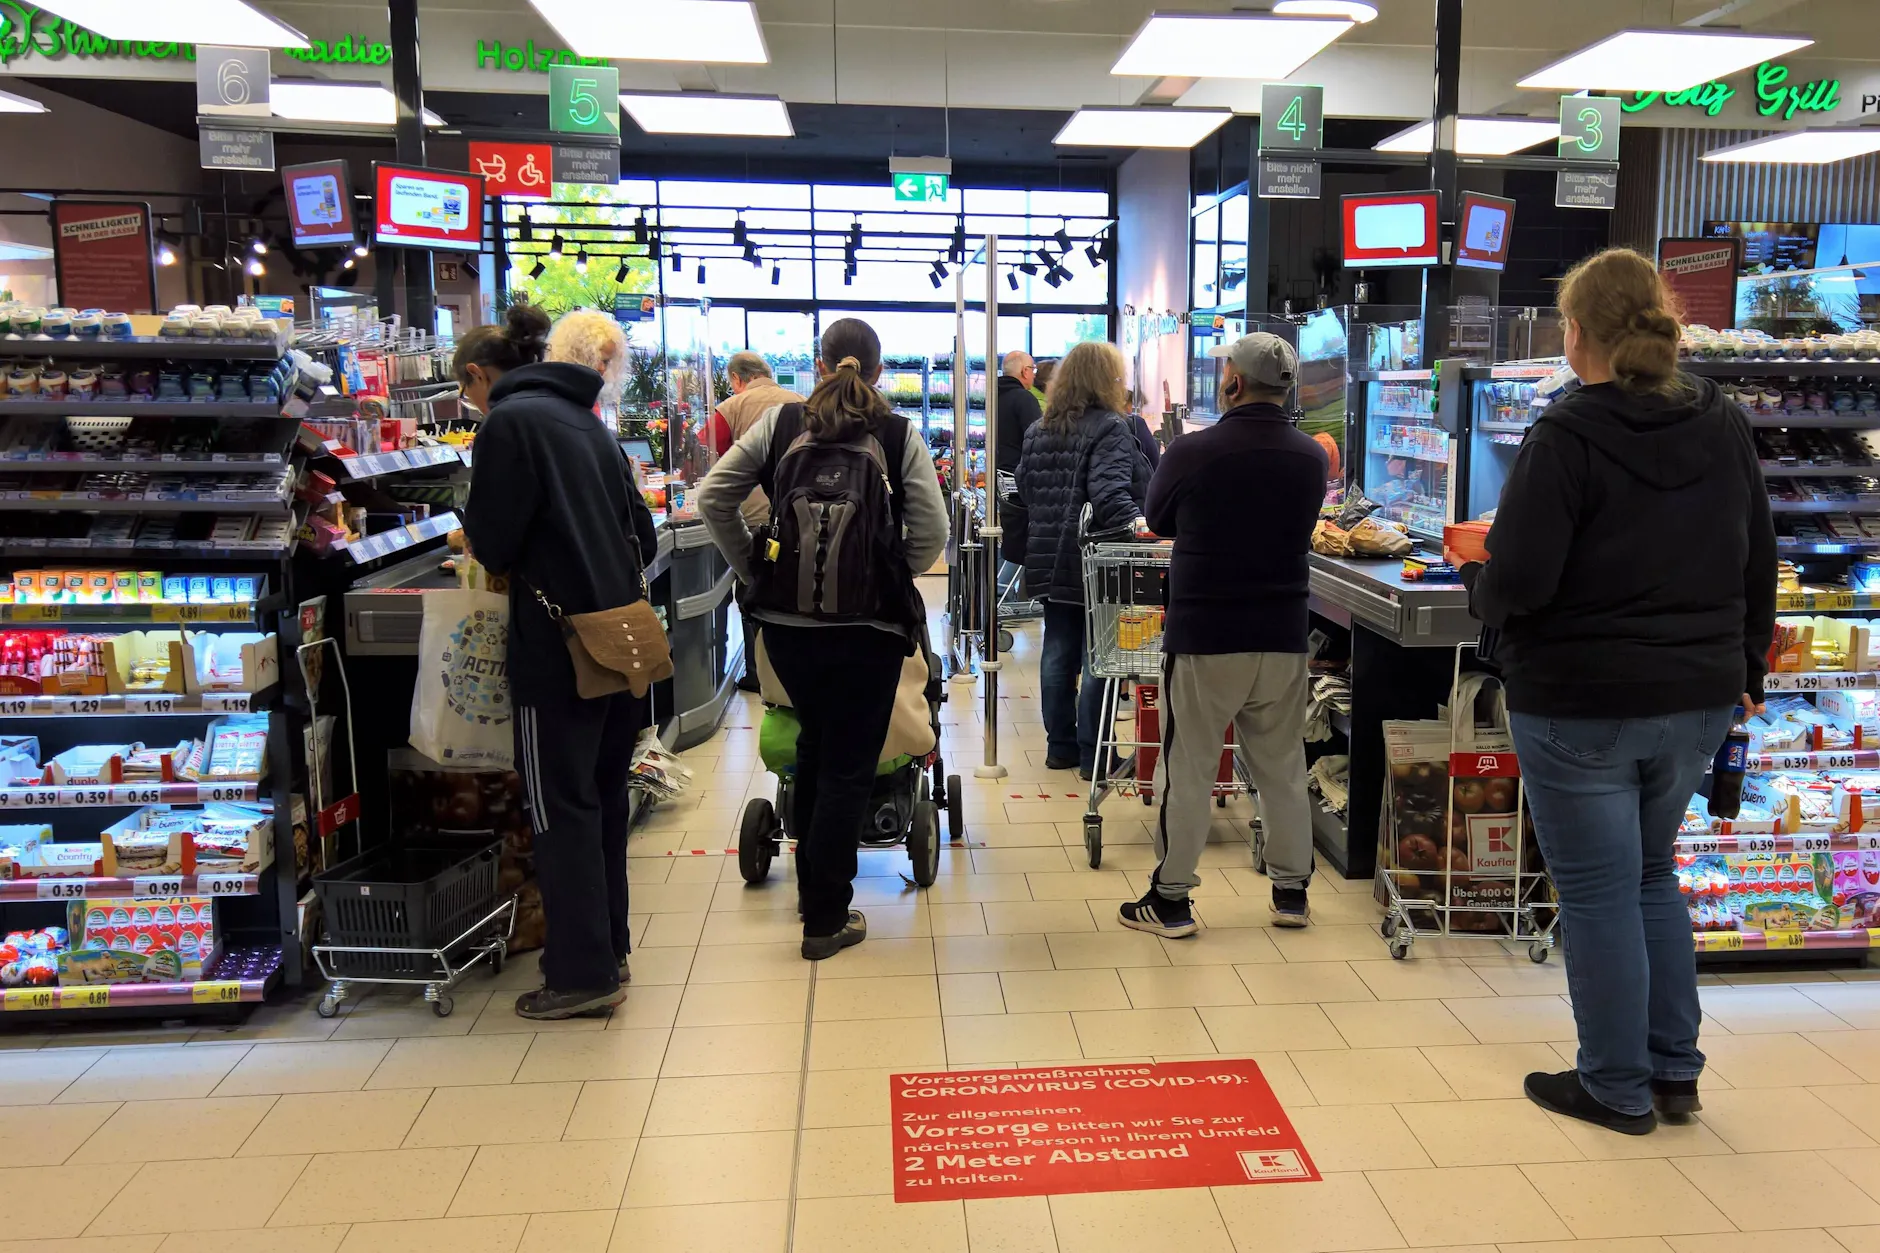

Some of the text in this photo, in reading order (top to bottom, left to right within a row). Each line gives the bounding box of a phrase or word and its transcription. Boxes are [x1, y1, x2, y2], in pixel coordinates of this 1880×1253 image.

[217, 59, 250, 106] 6
[1755, 62, 1841, 120] Grill
[569, 78, 600, 125] 5
[1277, 96, 1306, 140] 4
[1576, 107, 1603, 152] 3
[236, 132, 264, 143] nicht
[222, 144, 251, 153] mehr
[585, 149, 612, 160] nicht
[212, 155, 262, 166] anstellen
[571, 160, 599, 171] mehr
[1290, 163, 1313, 174] nicht
[562, 172, 609, 182] anstellen
[1277, 174, 1302, 184] mehr
[1587, 174, 1609, 185] nicht
[1268, 185, 1310, 194] anstellen
[1574, 184, 1599, 194] mehr
[1565, 194, 1605, 205] anstellen
[63, 216, 139, 234] SCHNELLIGKEIT
[111, 226, 136, 235] KASSE
[1665, 250, 1730, 268] SCHNELLIGKEIT
[1837, 595, 1852, 607] 0.89
[180, 606, 198, 618] 0.89
[229, 606, 248, 618] 0.89
[463, 656, 505, 677] ACTI
[1764, 678, 1780, 689] .19
[1795, 677, 1818, 689] 1.29
[1835, 676, 1857, 688] 1.19
[0, 701, 26, 713] 1.19
[69, 700, 99, 713] 1.29
[144, 700, 171, 713] 1.19
[221, 699, 248, 712] 1.19
[1784, 757, 1809, 769] 0.39
[1829, 756, 1855, 767] 0.65
[24, 792, 56, 805] 0.39
[75, 791, 107, 804] 0.39
[127, 790, 159, 803] 0.65
[212, 788, 243, 801] 0.89
[1741, 788, 1767, 804] bueno
[1749, 840, 1775, 851] 0.39
[1805, 838, 1830, 850] 0.99
[52, 884, 84, 898] 0.39
[149, 882, 180, 895] 0.99
[212, 880, 243, 893] 0.99
[1453, 886, 1478, 897] Über
[1480, 887, 1501, 898] 400
[1727, 935, 1742, 948] 1.09
[1788, 932, 1804, 945] 0.89
[33, 993, 50, 1007] 1.09
[88, 992, 107, 1005] 0.89
[220, 987, 239, 1000] 0.89
[900, 1067, 1151, 1086] Vorsorgemaßnahme
[900, 1074, 1250, 1098] CORONAVIRUS (COVID-19):
[902, 1106, 1082, 1122] Zur allgemeinen
[902, 1115, 1245, 1138] Vorsorge bitten wir Sie zur
[904, 1126, 1281, 1153] nächsten Person in Ihrem Umfeld
[904, 1143, 1190, 1171] 2 Meter Abstand
[905, 1172, 1024, 1187] zu halten.
